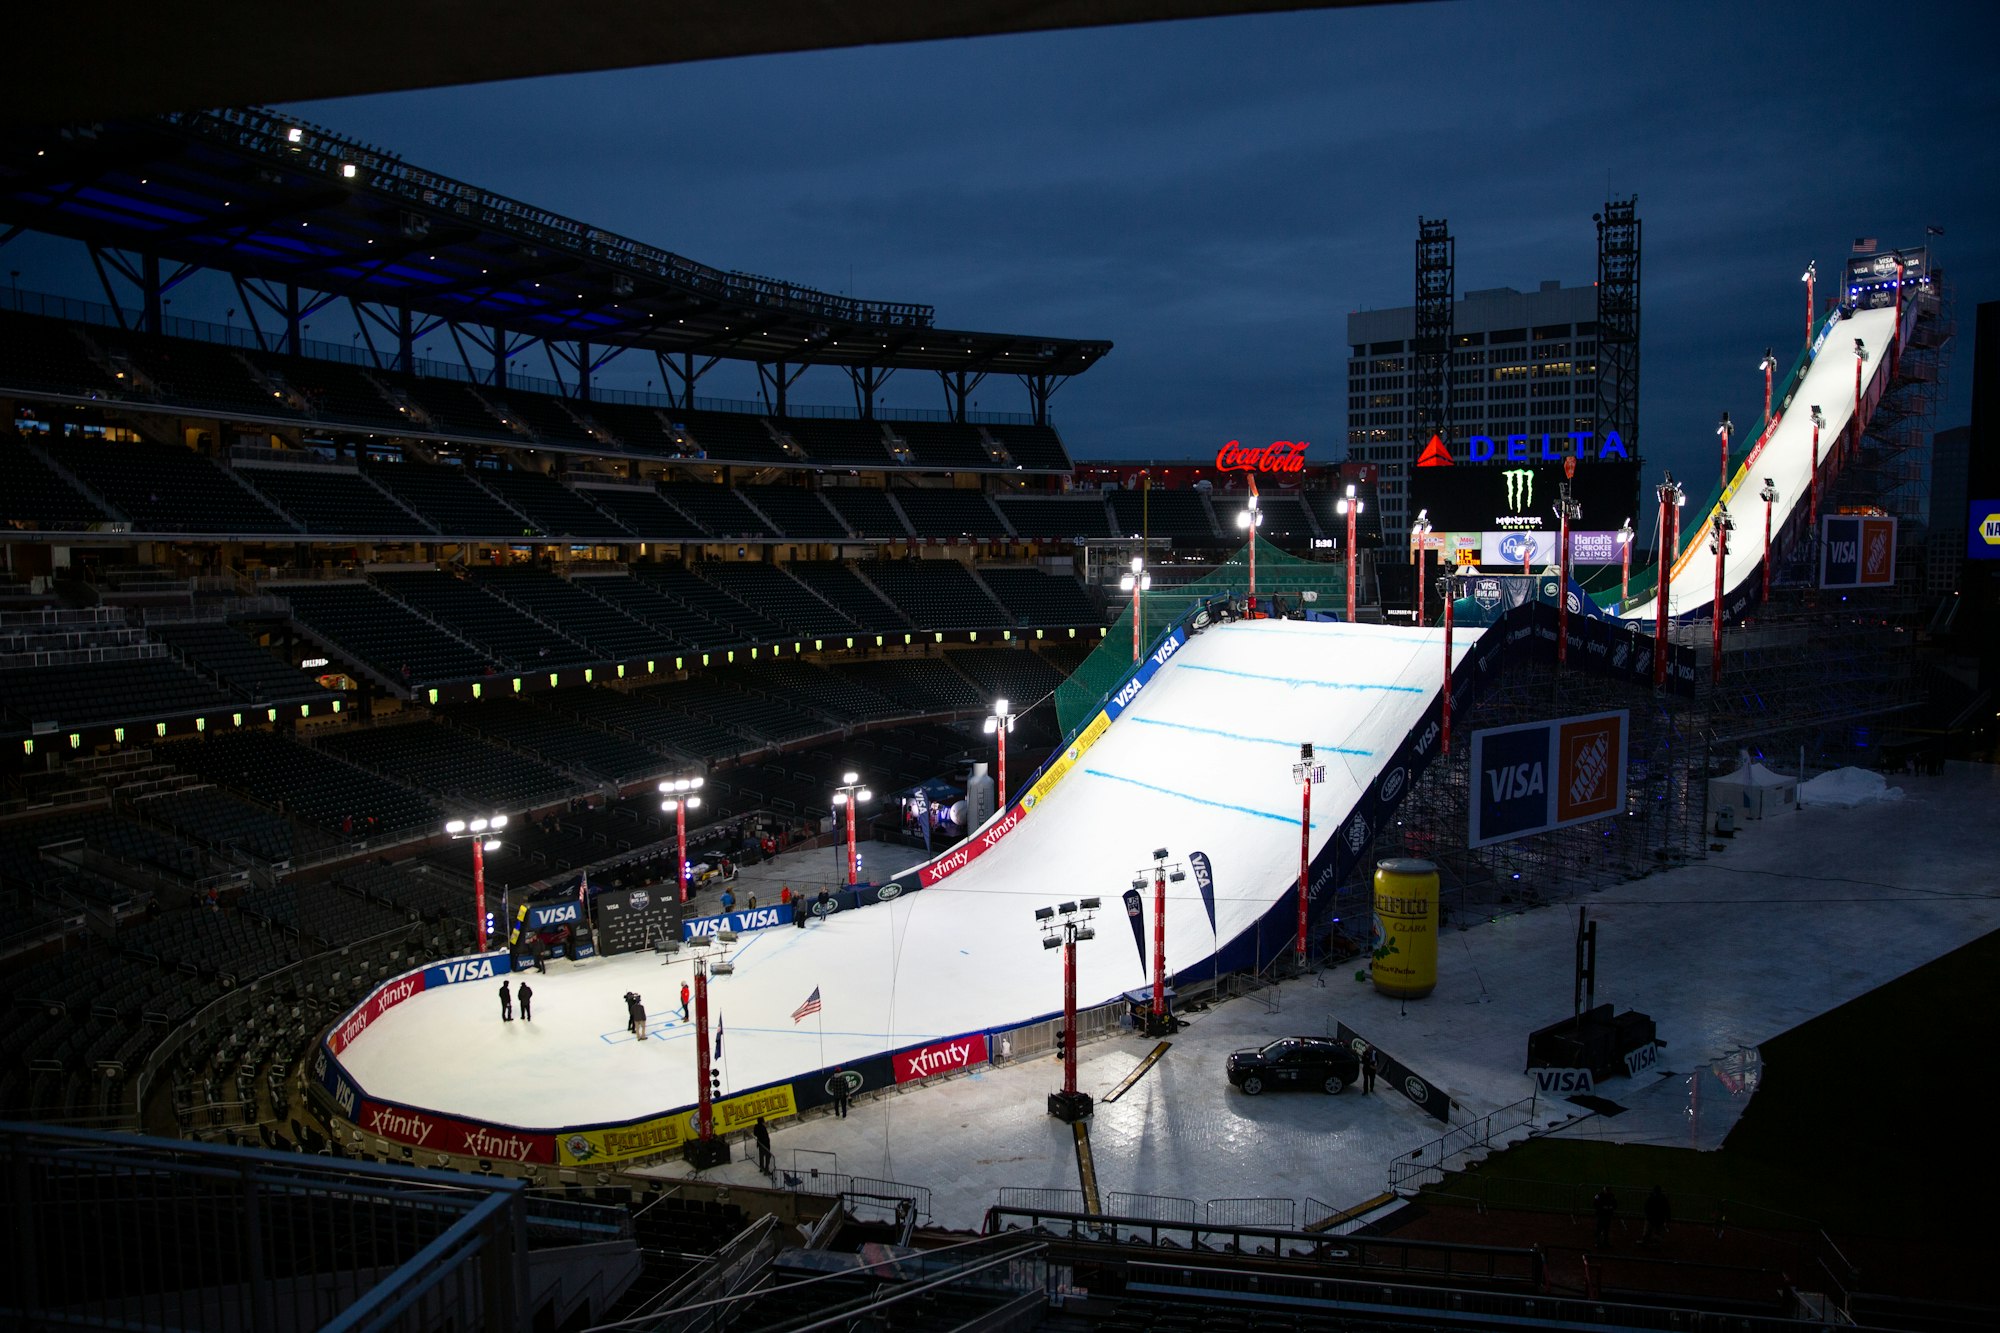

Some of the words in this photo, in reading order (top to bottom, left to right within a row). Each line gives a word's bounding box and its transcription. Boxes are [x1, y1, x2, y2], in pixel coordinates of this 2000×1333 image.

[1829, 309, 1841, 327] VISA
[1813, 334, 1824, 353] VISA
[1765, 416, 1778, 440] xfinity
[1216, 440, 1310, 473] Coca-Cola
[1469, 430, 1628, 462] DELTA
[1747, 442, 1761, 466] xfinity
[1495, 516, 1542, 525] MONSTER
[1574, 534, 1612, 545] Harrah's
[1830, 541, 1857, 564] VISA
[1481, 582, 1497, 590] VISA
[1152, 636, 1179, 665] VISA
[1678, 664, 1694, 681] VISA
[1112, 678, 1142, 708] VISA
[1413, 723, 1439, 755] VISA
[1486, 761, 1545, 803] VISA
[1570, 737, 1607, 803] HOME
[914, 788, 927, 814] VISA
[982, 812, 1017, 848] xfinity
[929, 849, 969, 880] xfinity
[1192, 853, 1211, 888] VISA
[1307, 864, 1334, 903] xfinity
[535, 905, 576, 925] VISA
[686, 917, 732, 938] VISA
[736, 909, 779, 930] VISA
[1393, 921, 1427, 932] CLARA
[519, 959, 535, 967] VISA
[578, 947, 593, 956] VISA
[440, 960, 494, 983] VISA
[378, 979, 415, 1012] xfinity
[342, 1009, 368, 1046] xfinity
[908, 1043, 970, 1077] xfinity
[1628, 1046, 1656, 1074] VISA
[336, 1074, 355, 1117] VISA
[1537, 1072, 1591, 1092] VISA
[722, 1093, 789, 1126] PACIFICO
[370, 1107, 433, 1146] xfinity
[603, 1123, 678, 1156] PACIFICO
[463, 1128, 533, 1161] xfinity
